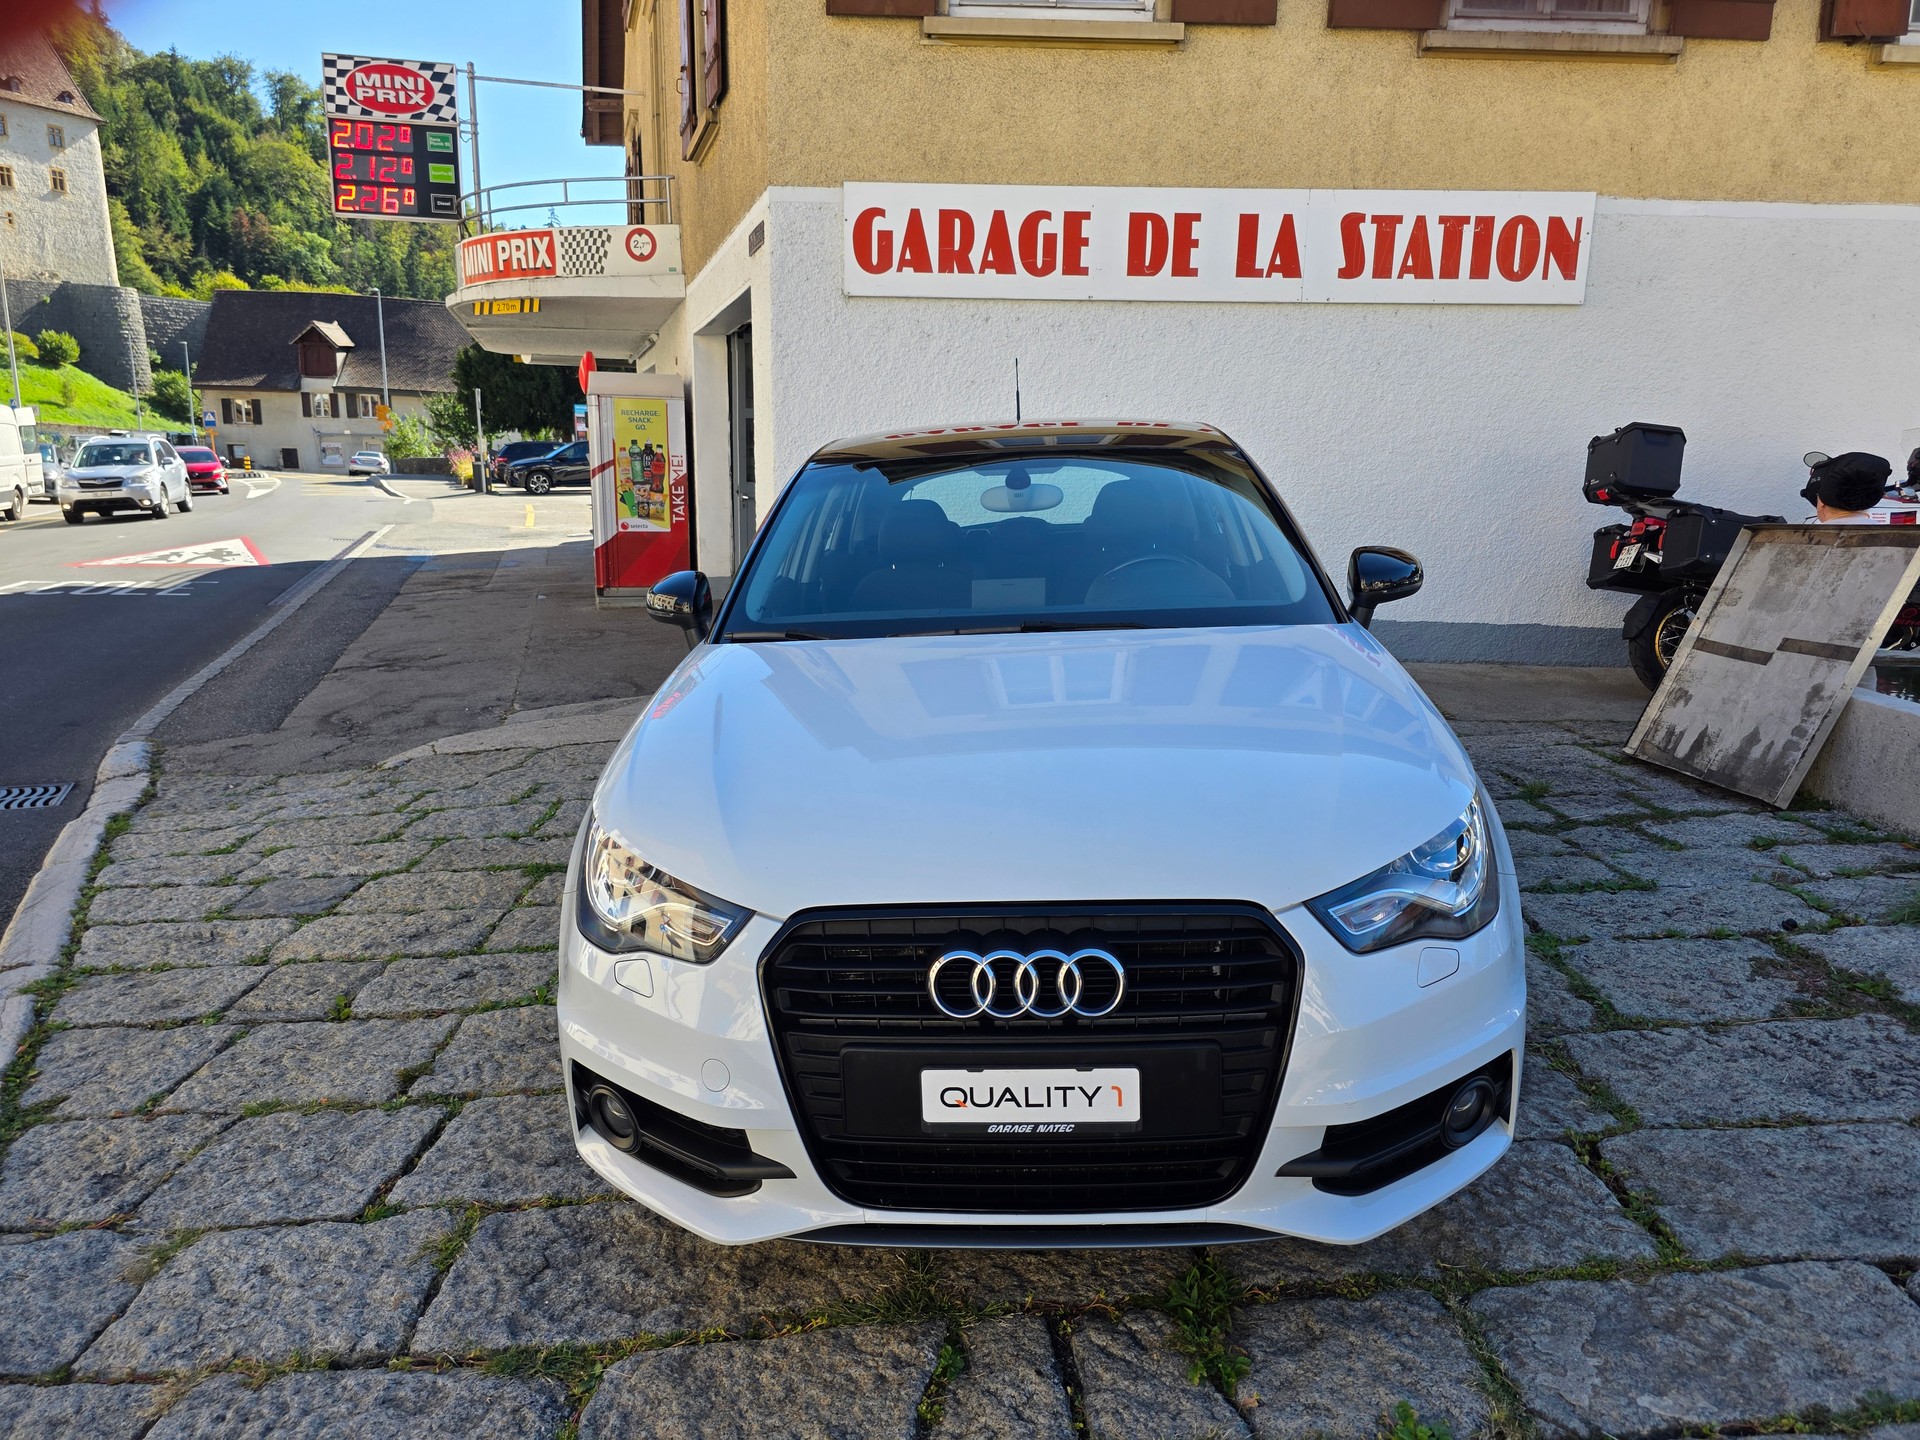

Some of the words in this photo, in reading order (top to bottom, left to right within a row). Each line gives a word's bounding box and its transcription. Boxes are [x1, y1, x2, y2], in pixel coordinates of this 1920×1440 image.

[354, 72, 425, 91] MINI
[355, 87, 427, 106] PRIX
[852, 207, 1092, 277] GARAGE
[1126, 212, 1202, 278] DE
[1235, 213, 1303, 279] LA
[1337, 212, 1582, 282] STATION
[463, 241, 494, 277] MINI
[497, 236, 553, 271] PRIX
[621, 409, 660, 417] RECHARGE.
[671, 454, 684, 480] ME!
[672, 485, 685, 523] TAKE
[0, 580, 219, 596] ECOLE
[940, 1086, 1103, 1109] QUALITY
[1110, 1085, 1123, 1107] 1
[987, 1124, 1034, 1133] GARAGE
[1036, 1124, 1075, 1133] NATEC
